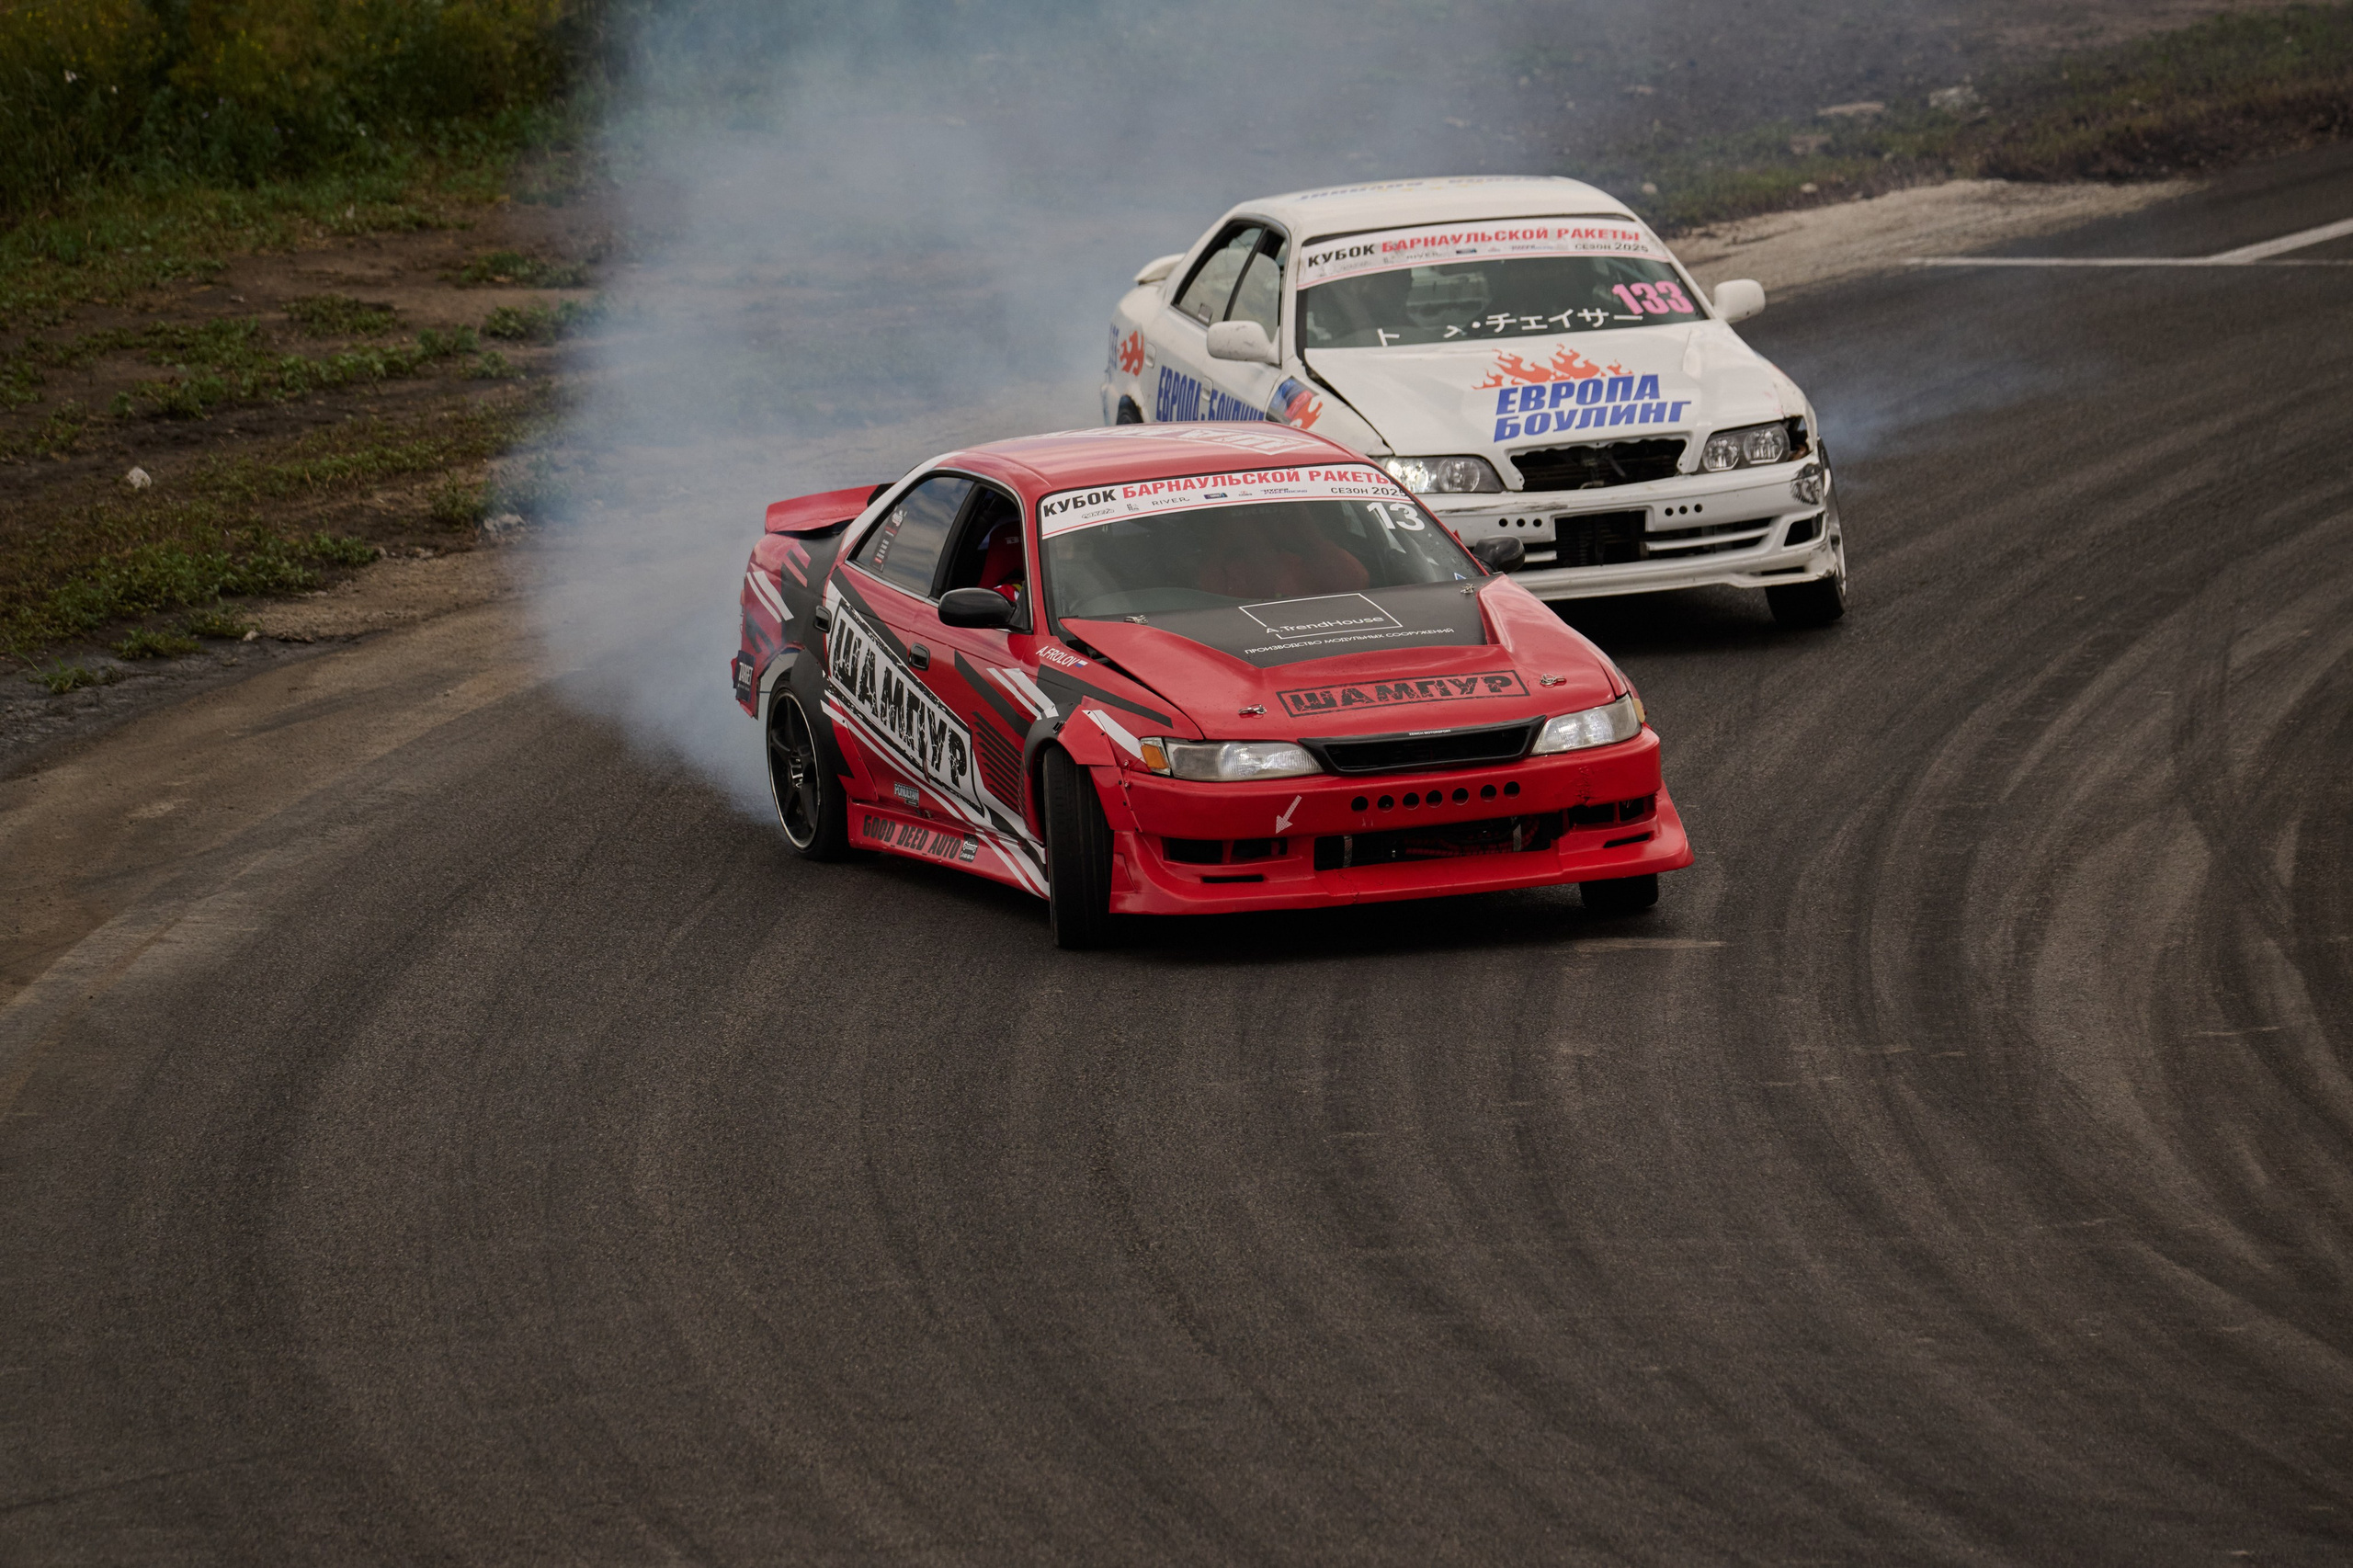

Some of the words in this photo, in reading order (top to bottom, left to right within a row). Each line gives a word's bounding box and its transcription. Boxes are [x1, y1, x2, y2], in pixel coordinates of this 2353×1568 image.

[1308, 243, 1375, 267] КУБОК
[1382, 226, 1548, 253] БАРНАУЛЬСКОЙ
[1557, 228, 1640, 242] РАКЕТЫ
[1575, 243, 1611, 251] СЕЗОН
[1615, 242, 1649, 253] 2025
[1611, 280, 1695, 315] 133
[1495, 374, 1660, 415] ЕВРОПА
[1494, 401, 1692, 443] БОУЛИНГ
[1043, 489, 1117, 517] КУБОК
[1122, 468, 1301, 499] БАРНАУЛЬСКОЙ
[1152, 496, 1190, 506] RIVER
[1367, 502, 1425, 531] 13
[1245, 640, 1323, 654] ПРОИЗВОДСТВО
[1324, 632, 1383, 644] МОДУЛЬНЫХ
[1386, 627, 1455, 638] СООРУЖЕНИЙ
[1266, 616, 1385, 634] A.TrendHouse
[1035, 645, 1080, 667] A.FROLOV
[833, 618, 968, 790] ШАМПУР
[1290, 675, 1513, 712] ШАМПУР
[862, 814, 896, 843] GOOD
[896, 824, 929, 851] DEED
[927, 833, 961, 859] AUTO
